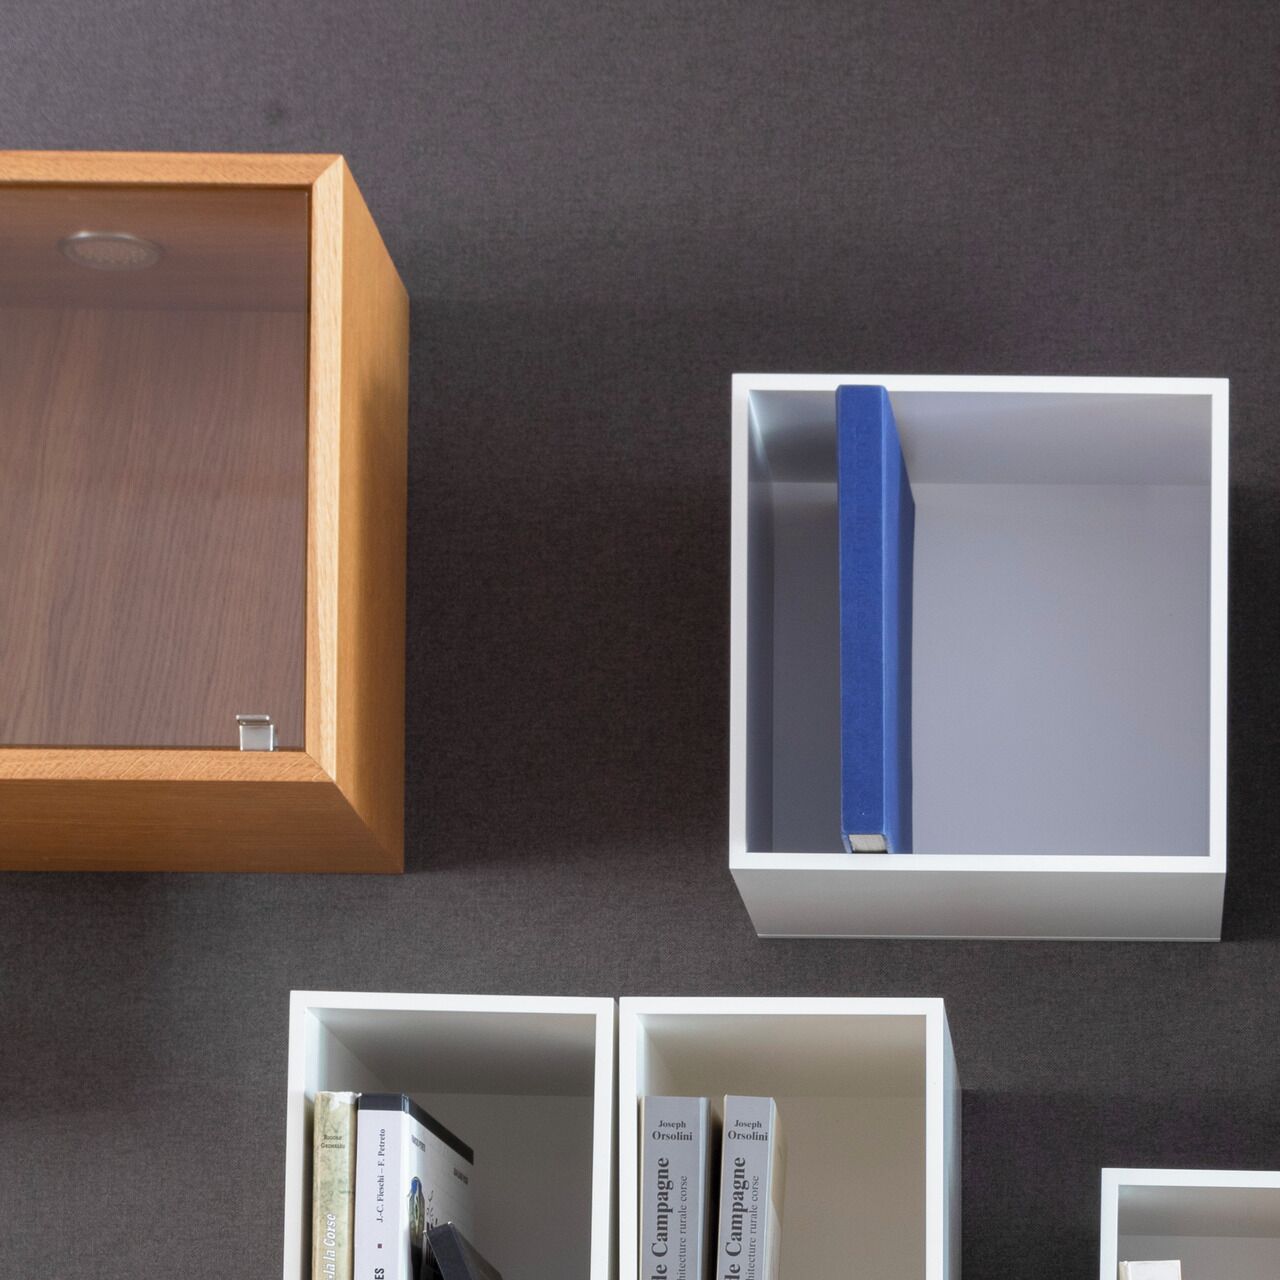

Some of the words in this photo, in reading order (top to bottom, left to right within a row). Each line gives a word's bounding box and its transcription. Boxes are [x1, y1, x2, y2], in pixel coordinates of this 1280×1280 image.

[652, 1130, 693, 1141] Orsolini
[658, 1120, 686, 1129] Joseph
[727, 1130, 769, 1141] Orsolini
[734, 1119, 762, 1129] Joseph
[378, 1128, 386, 1157] Petreto
[378, 1158, 385, 1167] F.
[679, 1175, 688, 1202] corse
[751, 1175, 760, 1202] corse
[376, 1204, 384, 1223] J.-C.
[651, 1157, 674, 1258] Campagne
[677, 1206, 687, 1235] rurale
[725, 1157, 750, 1258] Campagne
[749, 1206, 759, 1235] rurale
[323, 1213, 336, 1247] Corse
